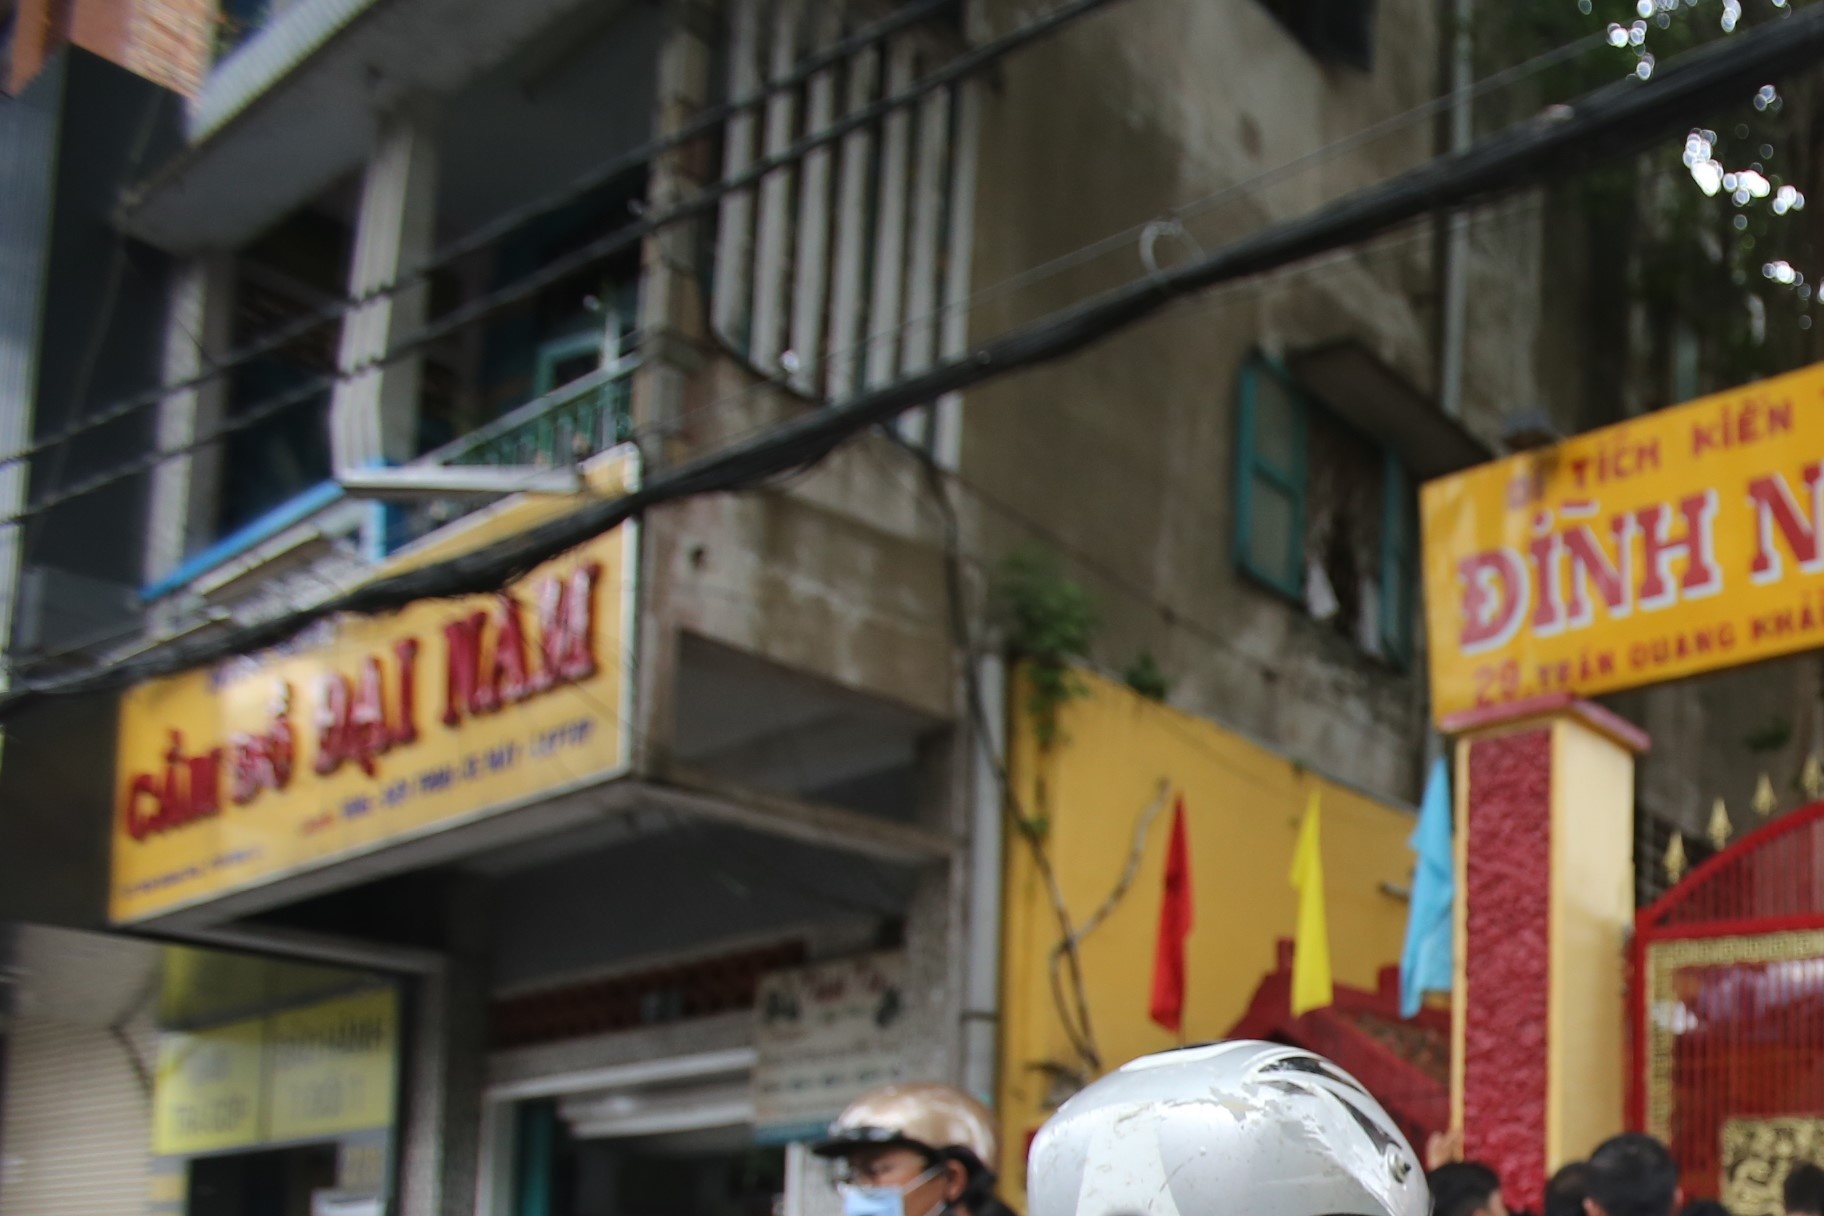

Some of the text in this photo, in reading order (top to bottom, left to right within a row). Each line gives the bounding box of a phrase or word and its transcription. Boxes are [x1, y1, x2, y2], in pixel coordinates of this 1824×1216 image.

[1569, 433, 1661, 492] TÍCH
[1690, 394, 1794, 458] KIẾN
[1456, 488, 1723, 657] ĐÌNH
[313, 636, 420, 779] ĐẠI
[441, 562, 605, 727] NAM
